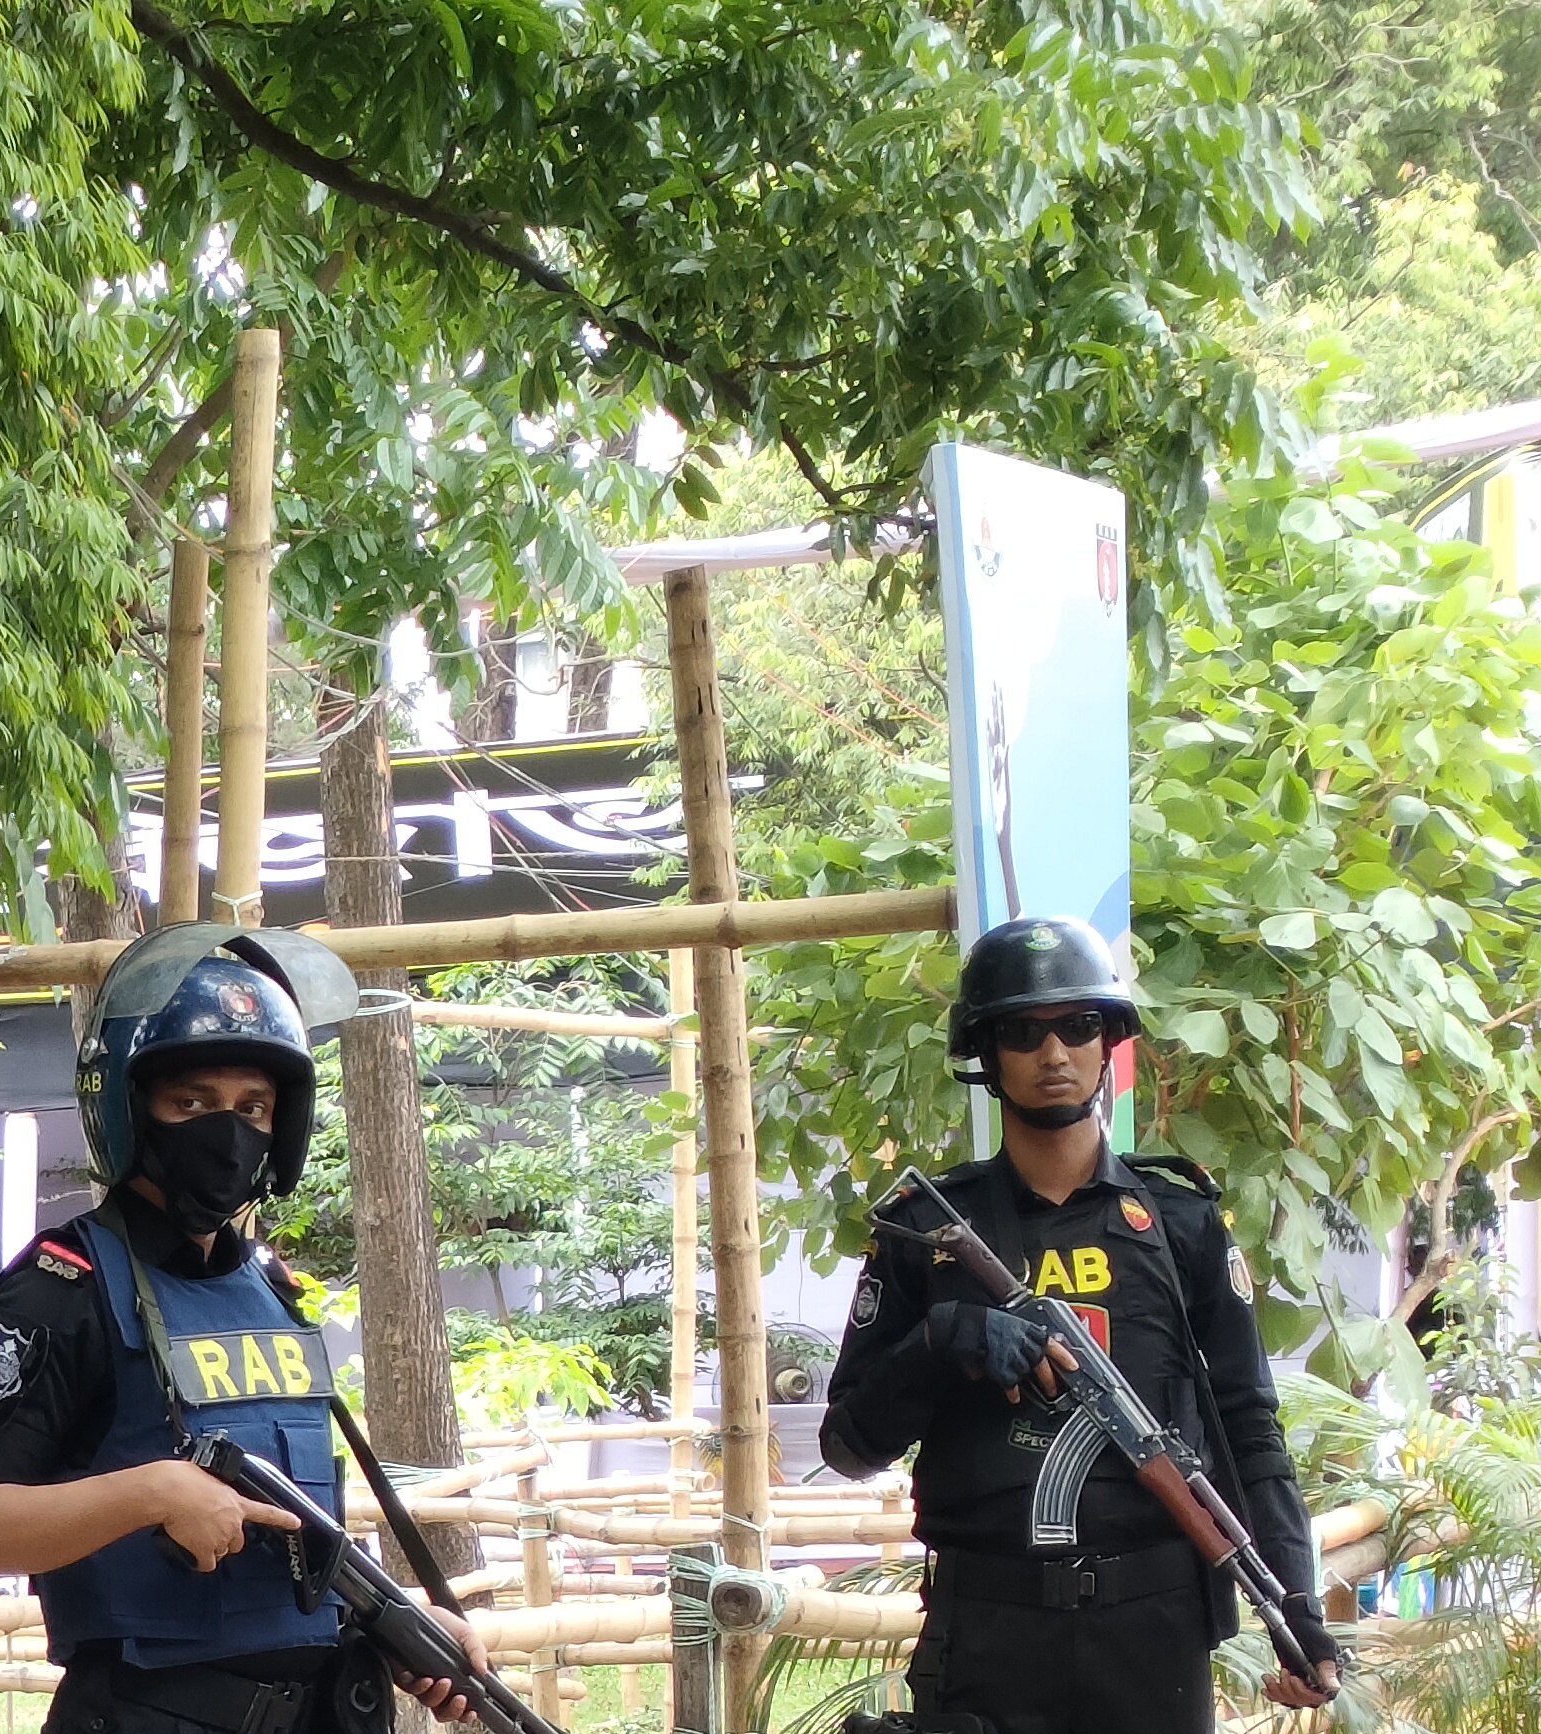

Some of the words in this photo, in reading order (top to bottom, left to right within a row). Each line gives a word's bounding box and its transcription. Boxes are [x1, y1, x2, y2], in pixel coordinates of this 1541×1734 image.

[76, 1071, 102, 1092] RAB
[37, 1254, 79, 1279] RAB
[1023, 1247, 1113, 1296] AB
[188, 1335, 312, 1399] RAB
